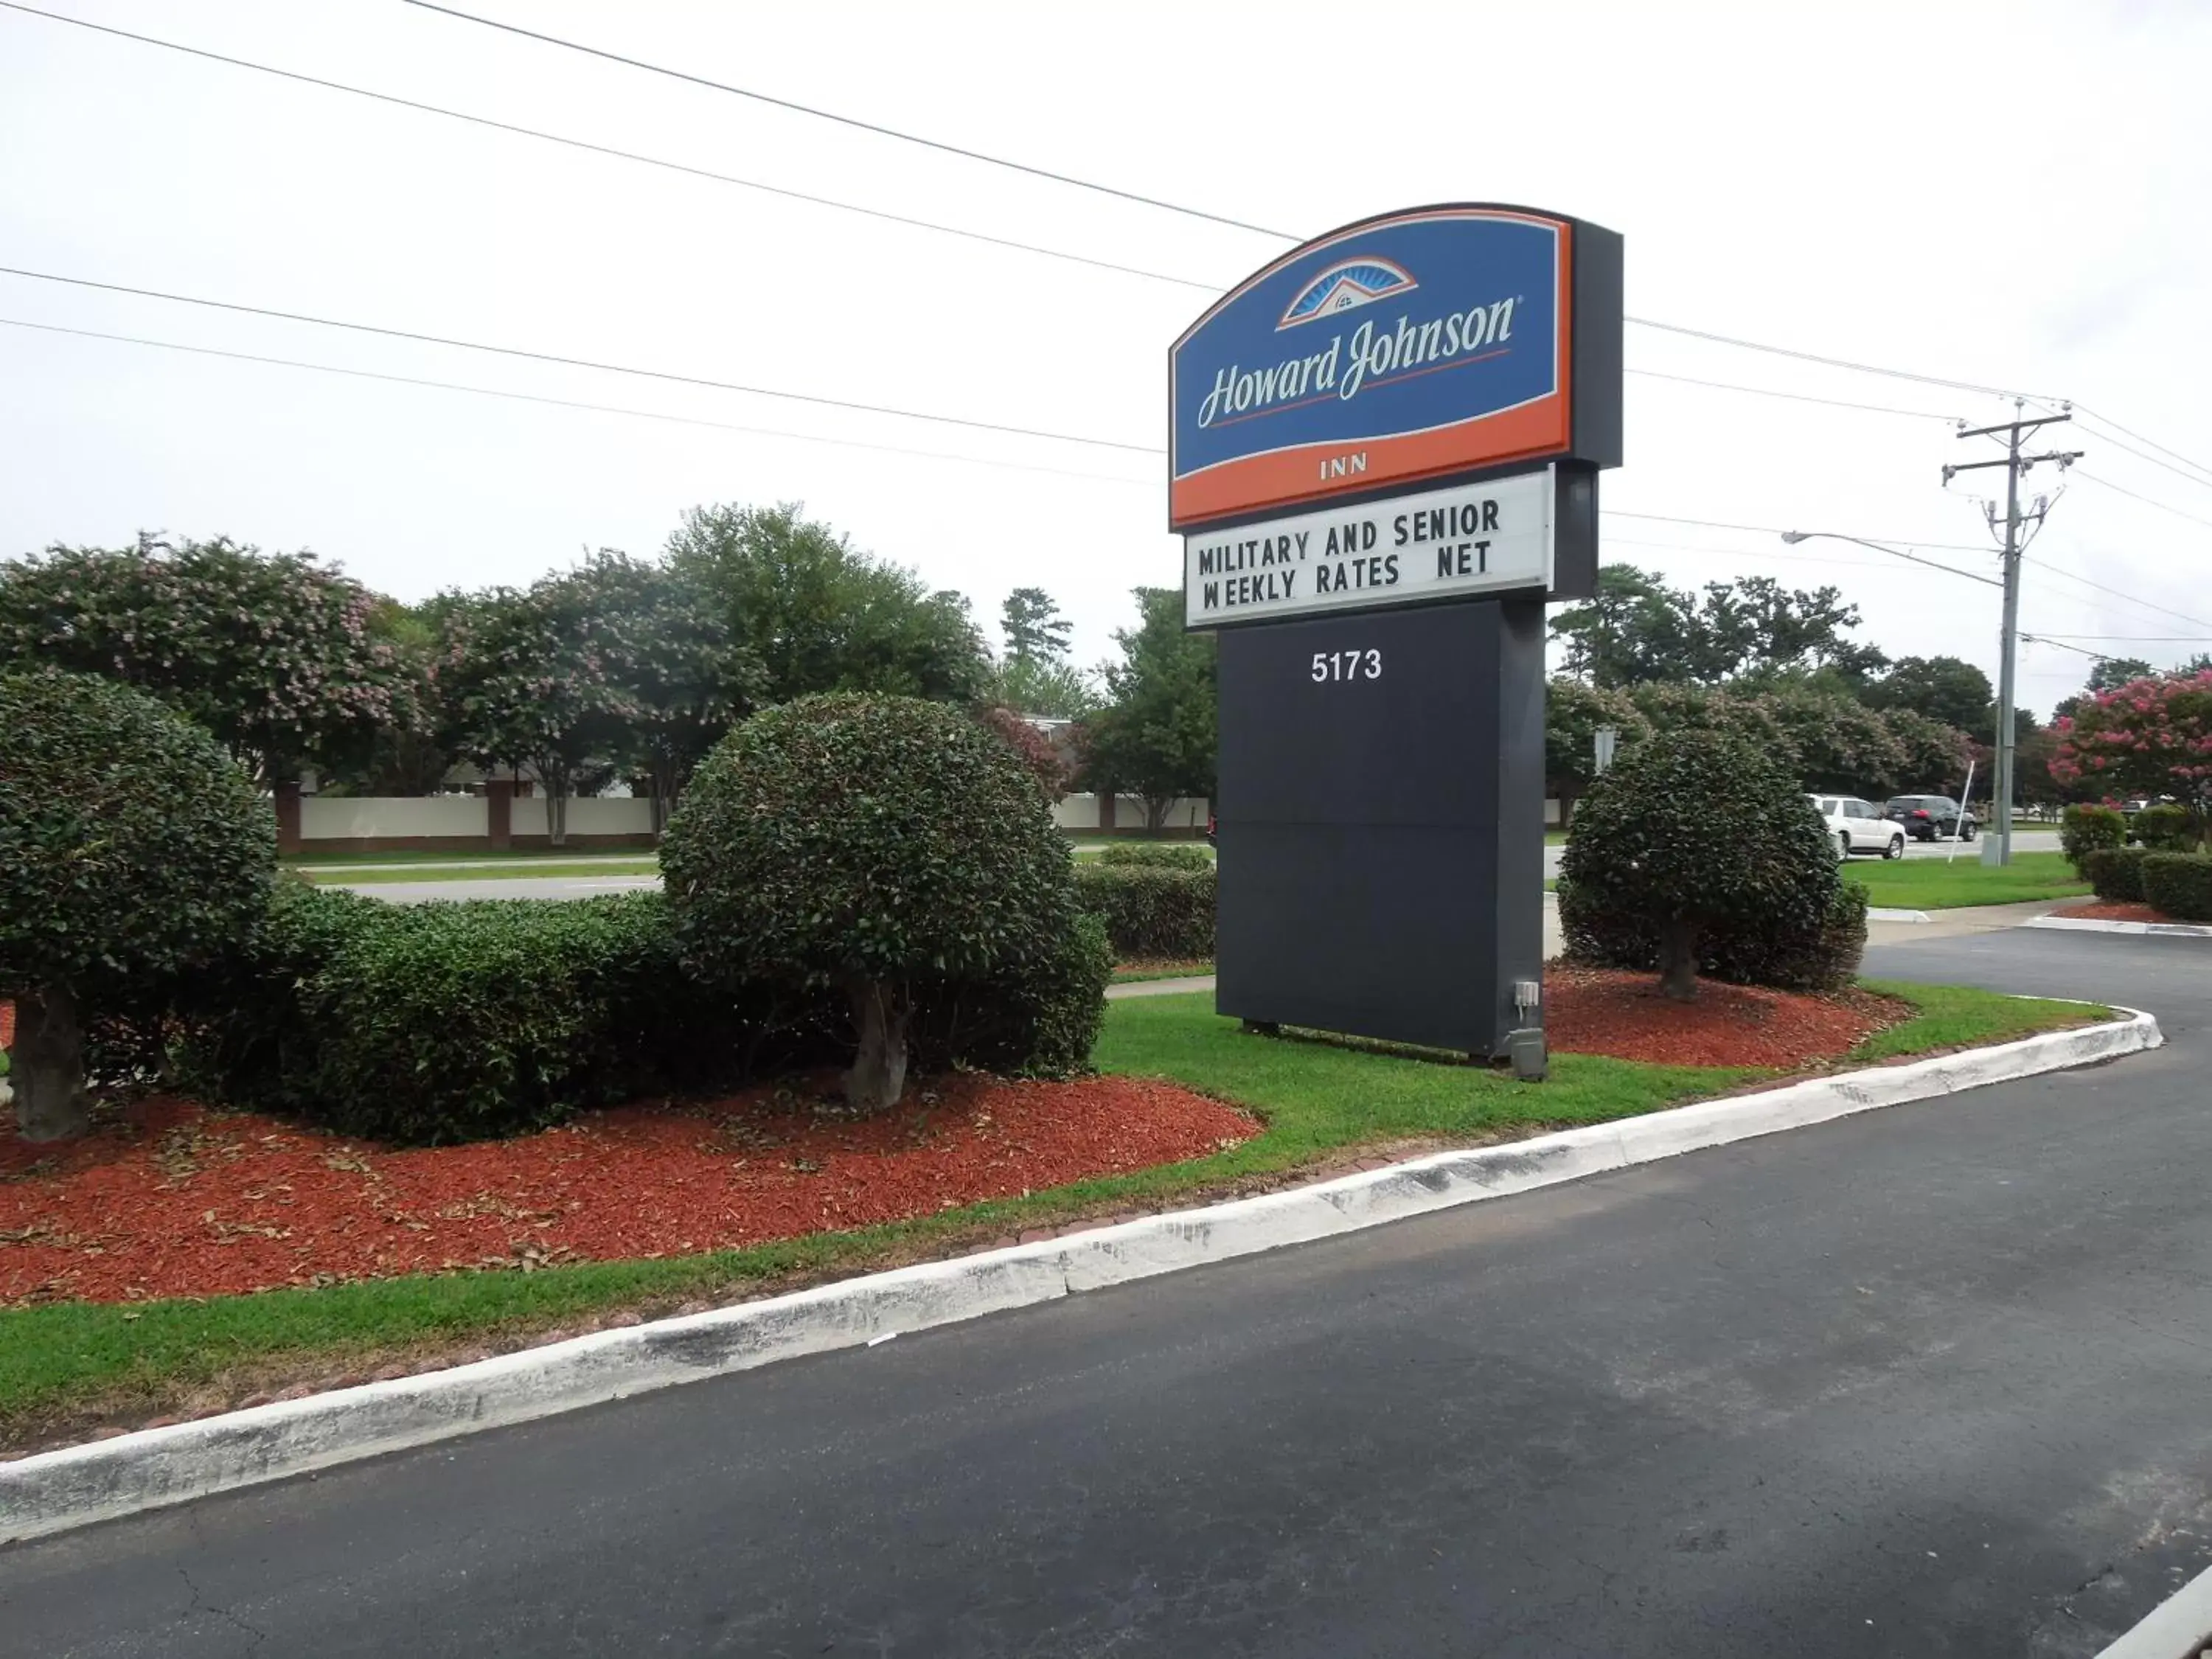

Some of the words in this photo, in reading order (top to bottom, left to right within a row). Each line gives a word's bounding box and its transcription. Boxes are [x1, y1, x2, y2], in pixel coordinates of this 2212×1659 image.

[1198, 335, 1340, 428] Howard
[1339, 296, 1516, 400] Johnson
[1320, 452, 1368, 480] INN
[1199, 530, 1310, 576] MILITARY
[1325, 521, 1377, 556] AND
[1394, 499, 1499, 546] SENIOR
[1203, 569, 1295, 609] WEEKLY
[1316, 554, 1399, 593] RATES
[1437, 540, 1492, 578] NET
[1311, 648, 1382, 682] 5173
